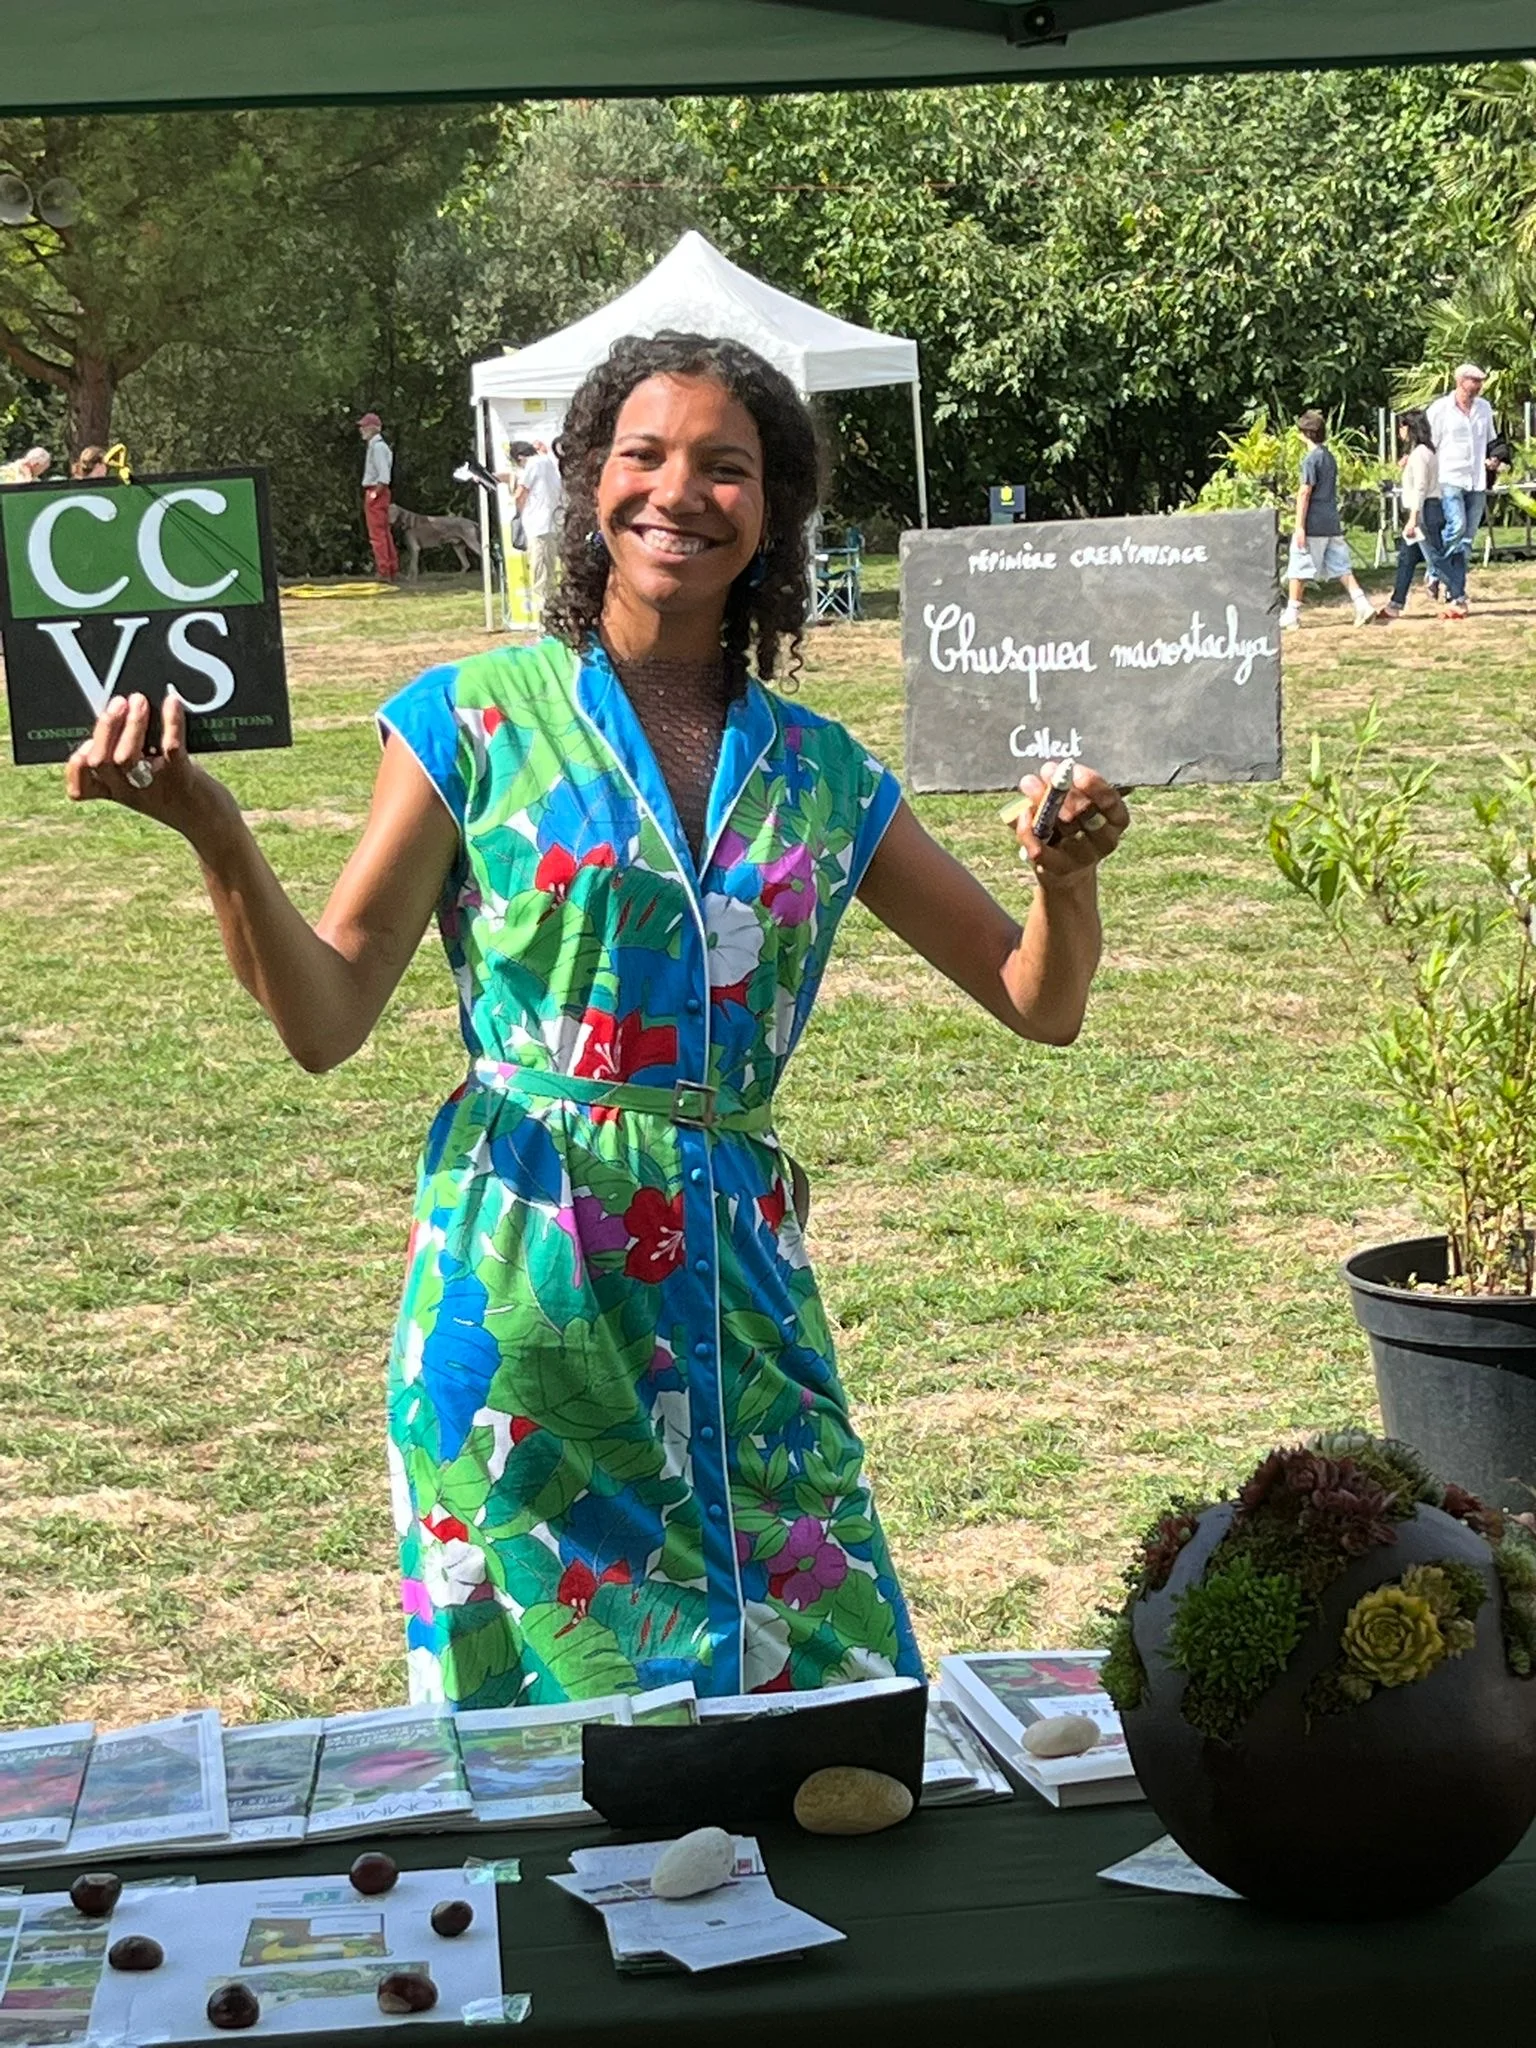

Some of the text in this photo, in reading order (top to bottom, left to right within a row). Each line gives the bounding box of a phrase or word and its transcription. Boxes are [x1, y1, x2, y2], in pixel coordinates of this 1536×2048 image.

[27, 488, 239, 607] CC
[37, 611, 235, 717] VS
[924, 604, 1097, 703] Chusquea
